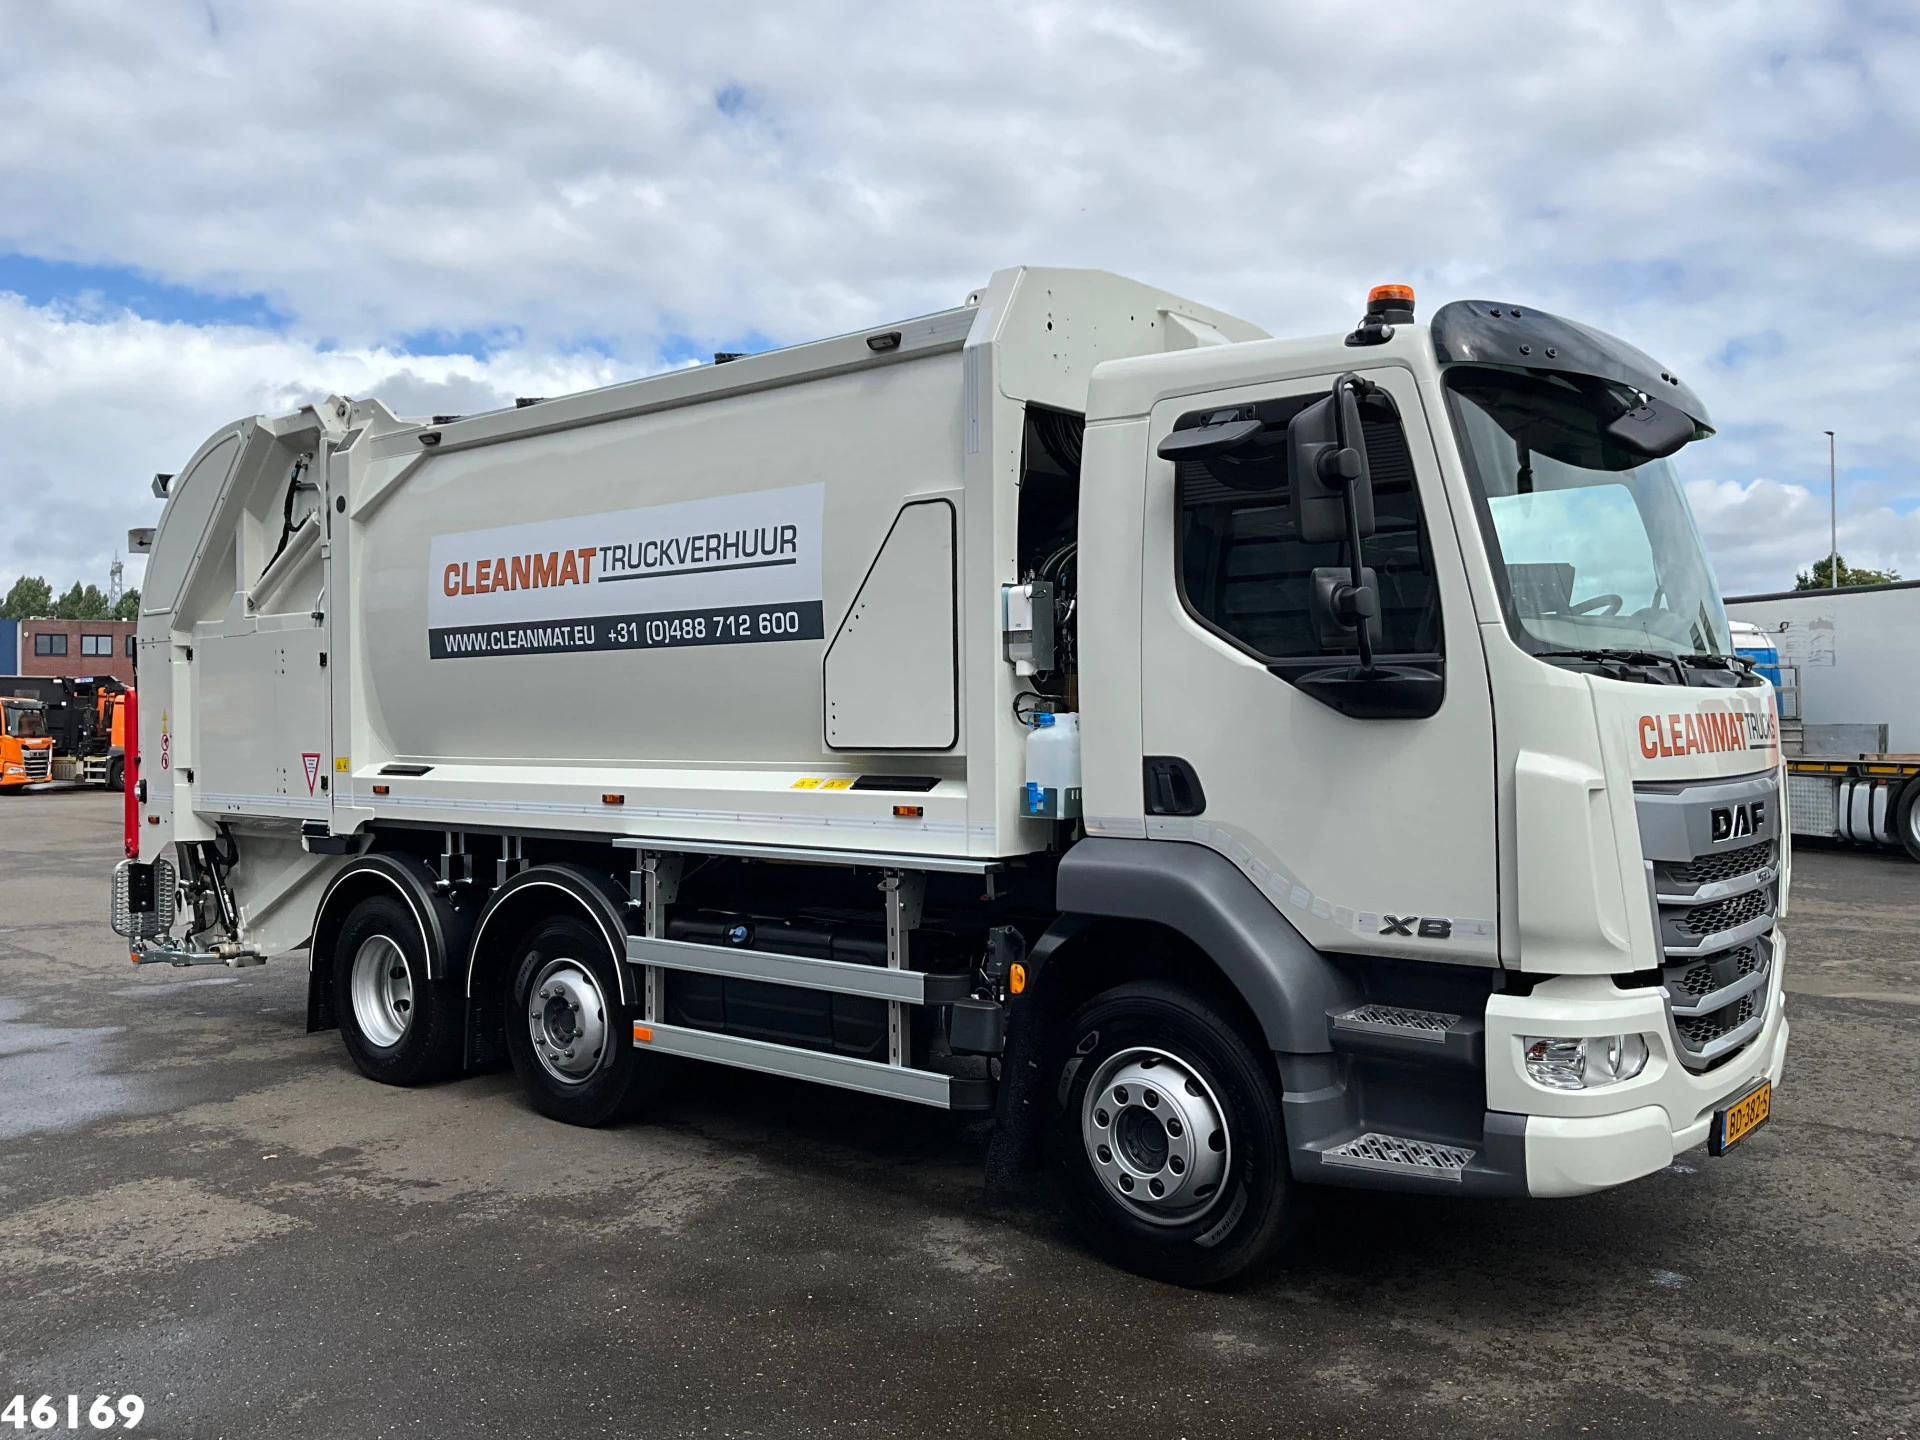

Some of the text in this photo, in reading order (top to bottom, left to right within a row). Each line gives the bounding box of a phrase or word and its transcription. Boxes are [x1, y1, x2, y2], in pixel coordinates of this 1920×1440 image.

[443, 524, 798, 597] CLEANMAT TRUCKVERHUUR
[444, 611, 799, 653] WWW.CLEANMAT.EU +31 (0)488 712 600
[1638, 712, 1747, 759] CLEANMAT
[1710, 801, 1765, 844] DAF
